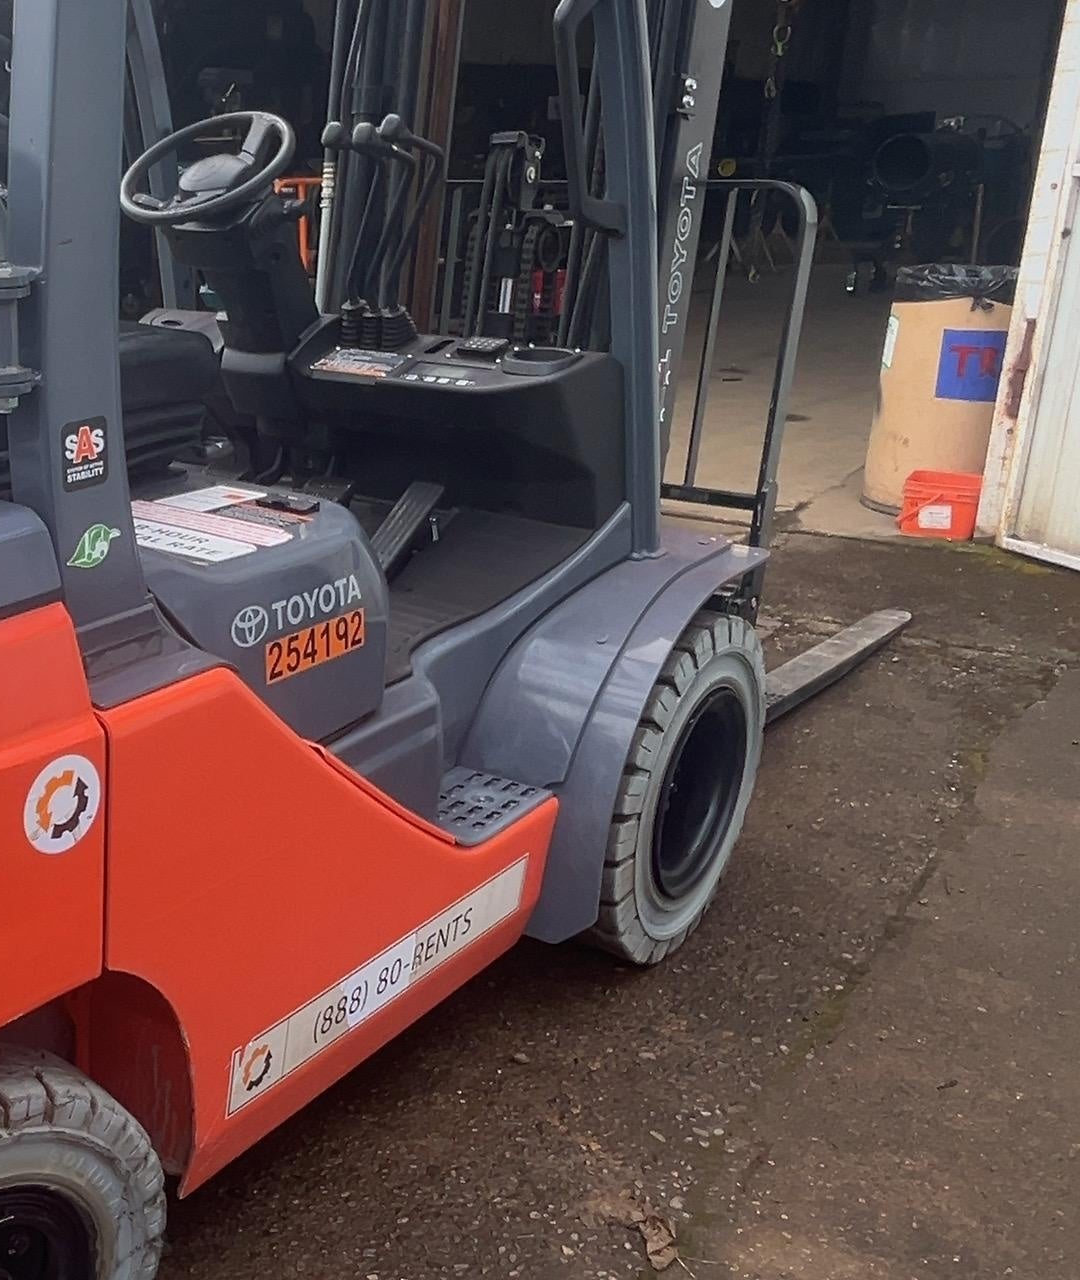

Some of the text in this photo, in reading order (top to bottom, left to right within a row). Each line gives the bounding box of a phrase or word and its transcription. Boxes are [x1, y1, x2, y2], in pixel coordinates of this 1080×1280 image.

[661, 141, 704, 334] TOYOTA
[64, 425, 105, 464] SAS
[66, 466, 104, 484] STABILITY
[271, 574, 363, 631] TOYOTA
[267, 610, 364, 681] 254192
[312, 907, 473, 1044] (888) 80-RENTS
